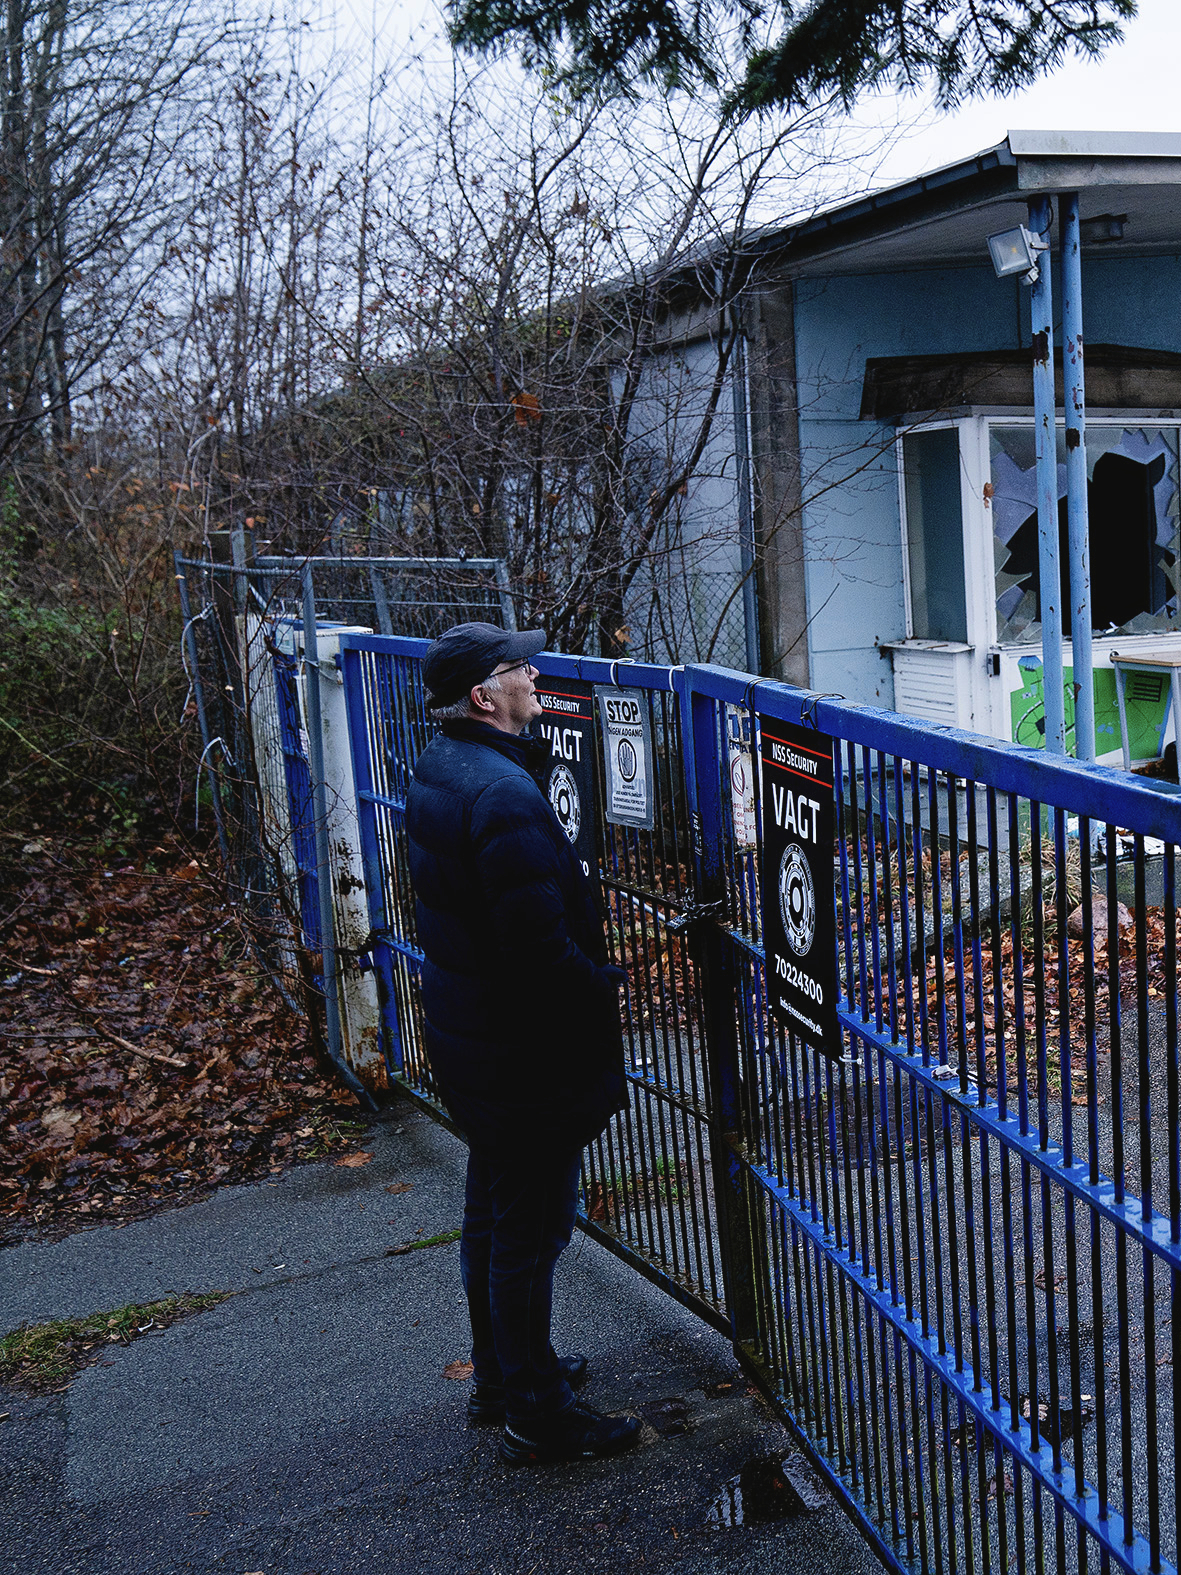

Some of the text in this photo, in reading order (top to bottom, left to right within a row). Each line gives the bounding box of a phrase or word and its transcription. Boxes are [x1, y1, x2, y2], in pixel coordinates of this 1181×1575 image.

[540, 694, 580, 713] NSS SECURITY
[606, 699, 639, 722] STOP
[540, 723, 583, 762] VAGT
[772, 742, 786, 763] NSS
[786, 748, 818, 775] SECURITY
[772, 782, 821, 845] VAGT
[774, 953, 824, 1005] 70224300
